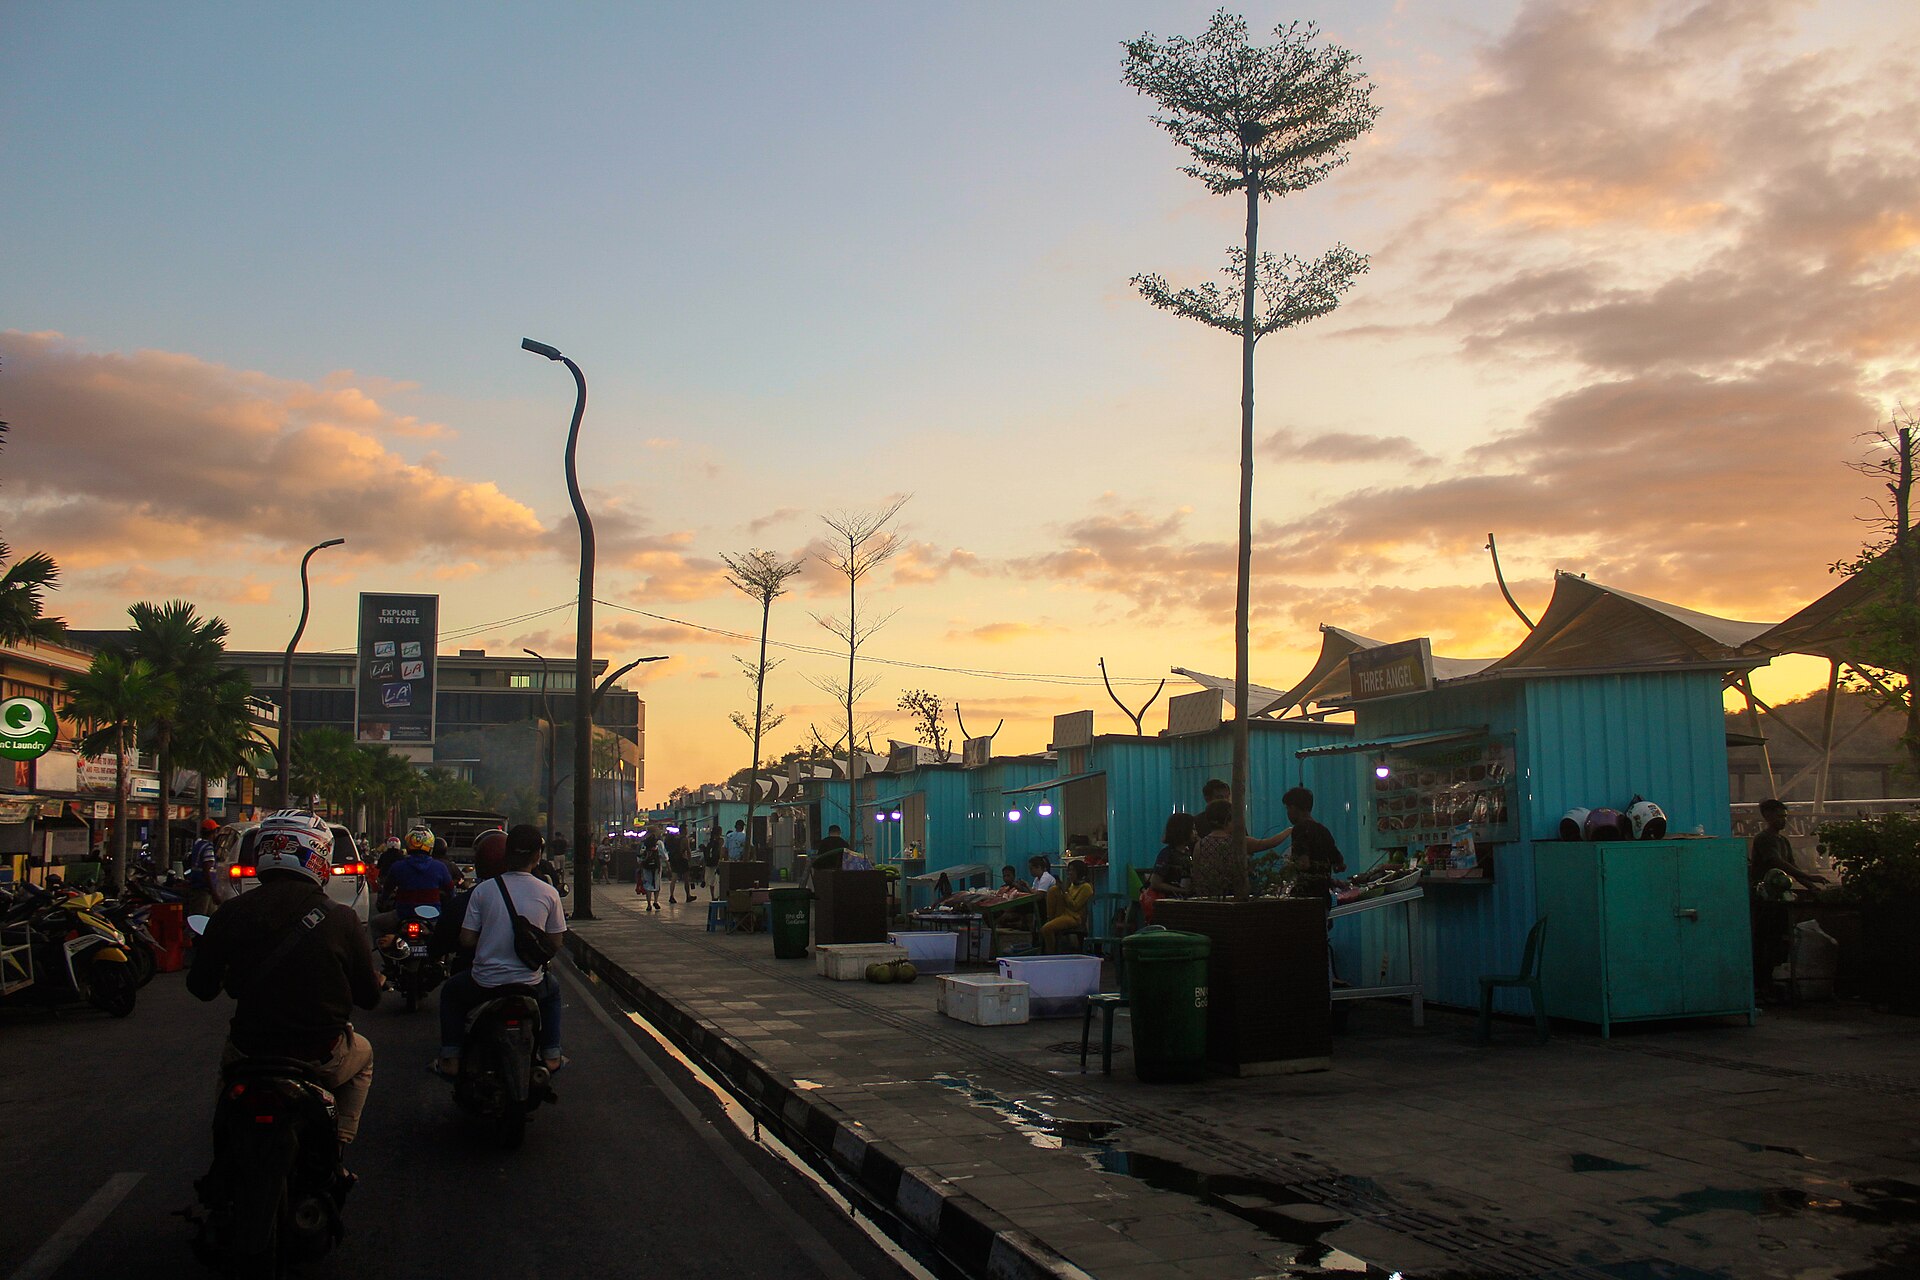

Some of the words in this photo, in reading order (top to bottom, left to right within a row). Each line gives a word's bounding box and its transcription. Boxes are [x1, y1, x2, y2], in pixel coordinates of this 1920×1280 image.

[381, 609, 417, 617] EXPLORE
[1358, 671, 1385, 693] THREE
[1386, 664, 1415, 690] ANGEL
[13, 741, 46, 751] Laundry
[207, 778, 223, 788] BNI
